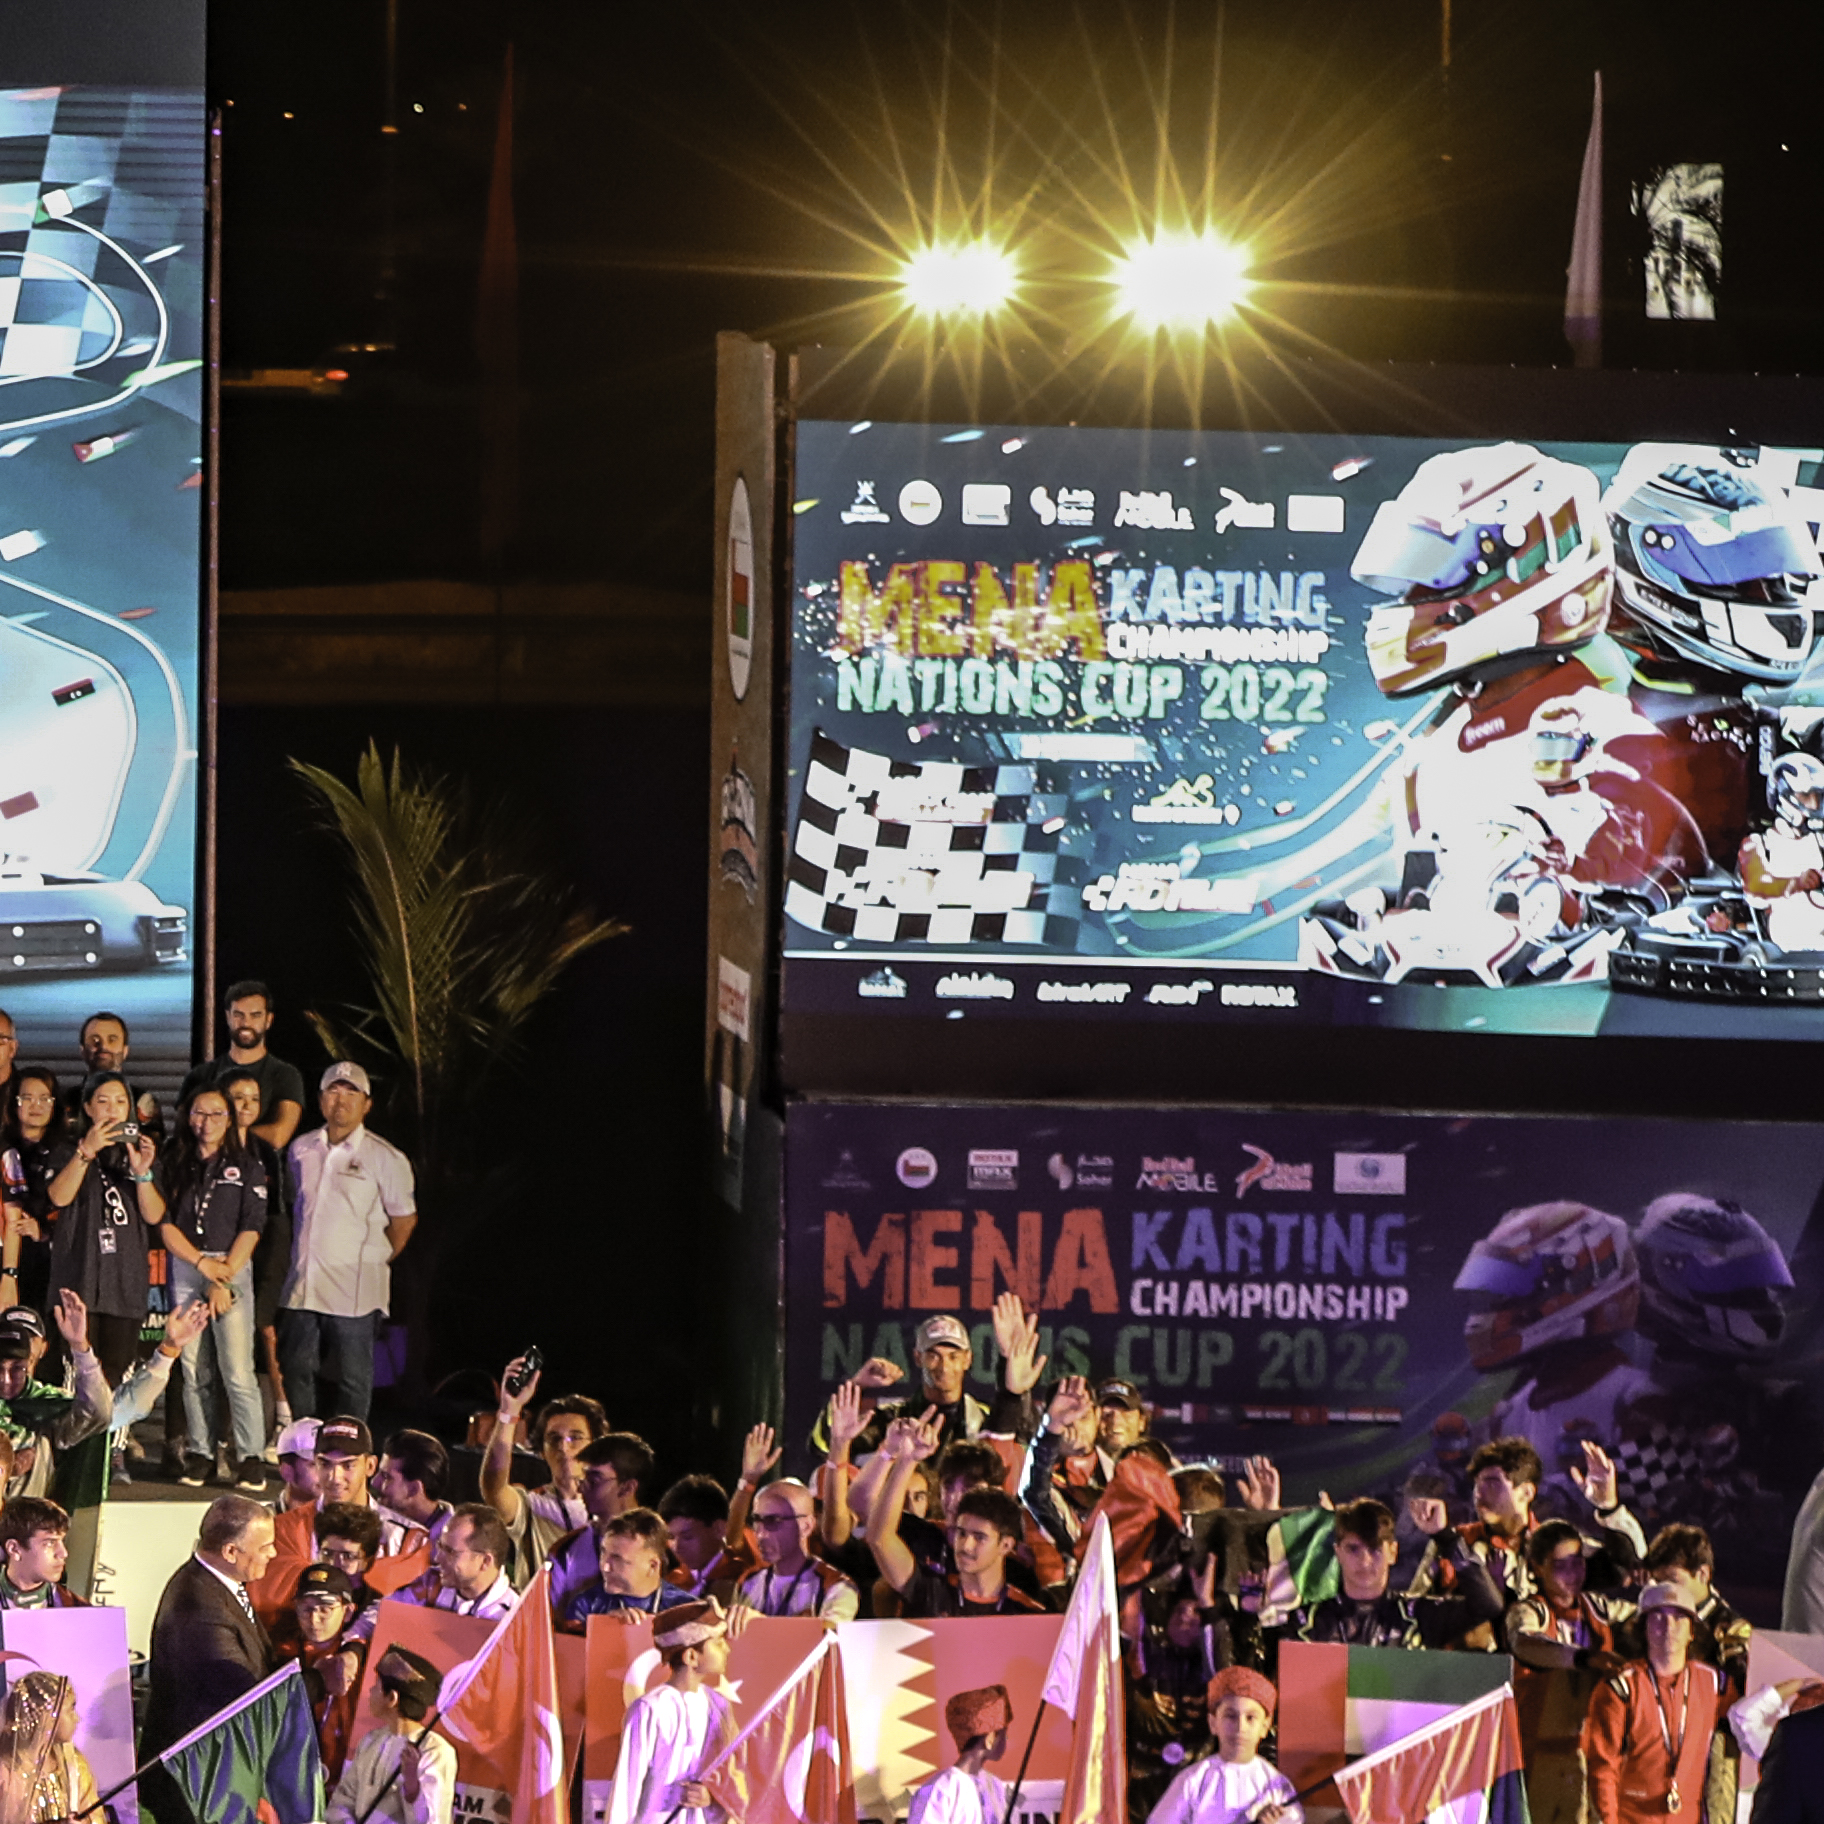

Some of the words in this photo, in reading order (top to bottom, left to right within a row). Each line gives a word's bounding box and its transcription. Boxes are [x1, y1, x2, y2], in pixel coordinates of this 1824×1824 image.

[836, 558, 1110, 664] MENA
[1109, 565, 1329, 628] KARTING
[835, 657, 1066, 716] NATIONS
[1080, 663, 1184, 719] CUP
[1199, 665, 1330, 723] 2022
[822, 1208, 1120, 1314] MENA
[1131, 1206, 1407, 1277] KARTING
[1129, 1278, 1409, 1322] CHAMPIONSHIP
[1114, 1325, 1234, 1388] CUP
[1258, 1328, 1410, 1392] 2022
